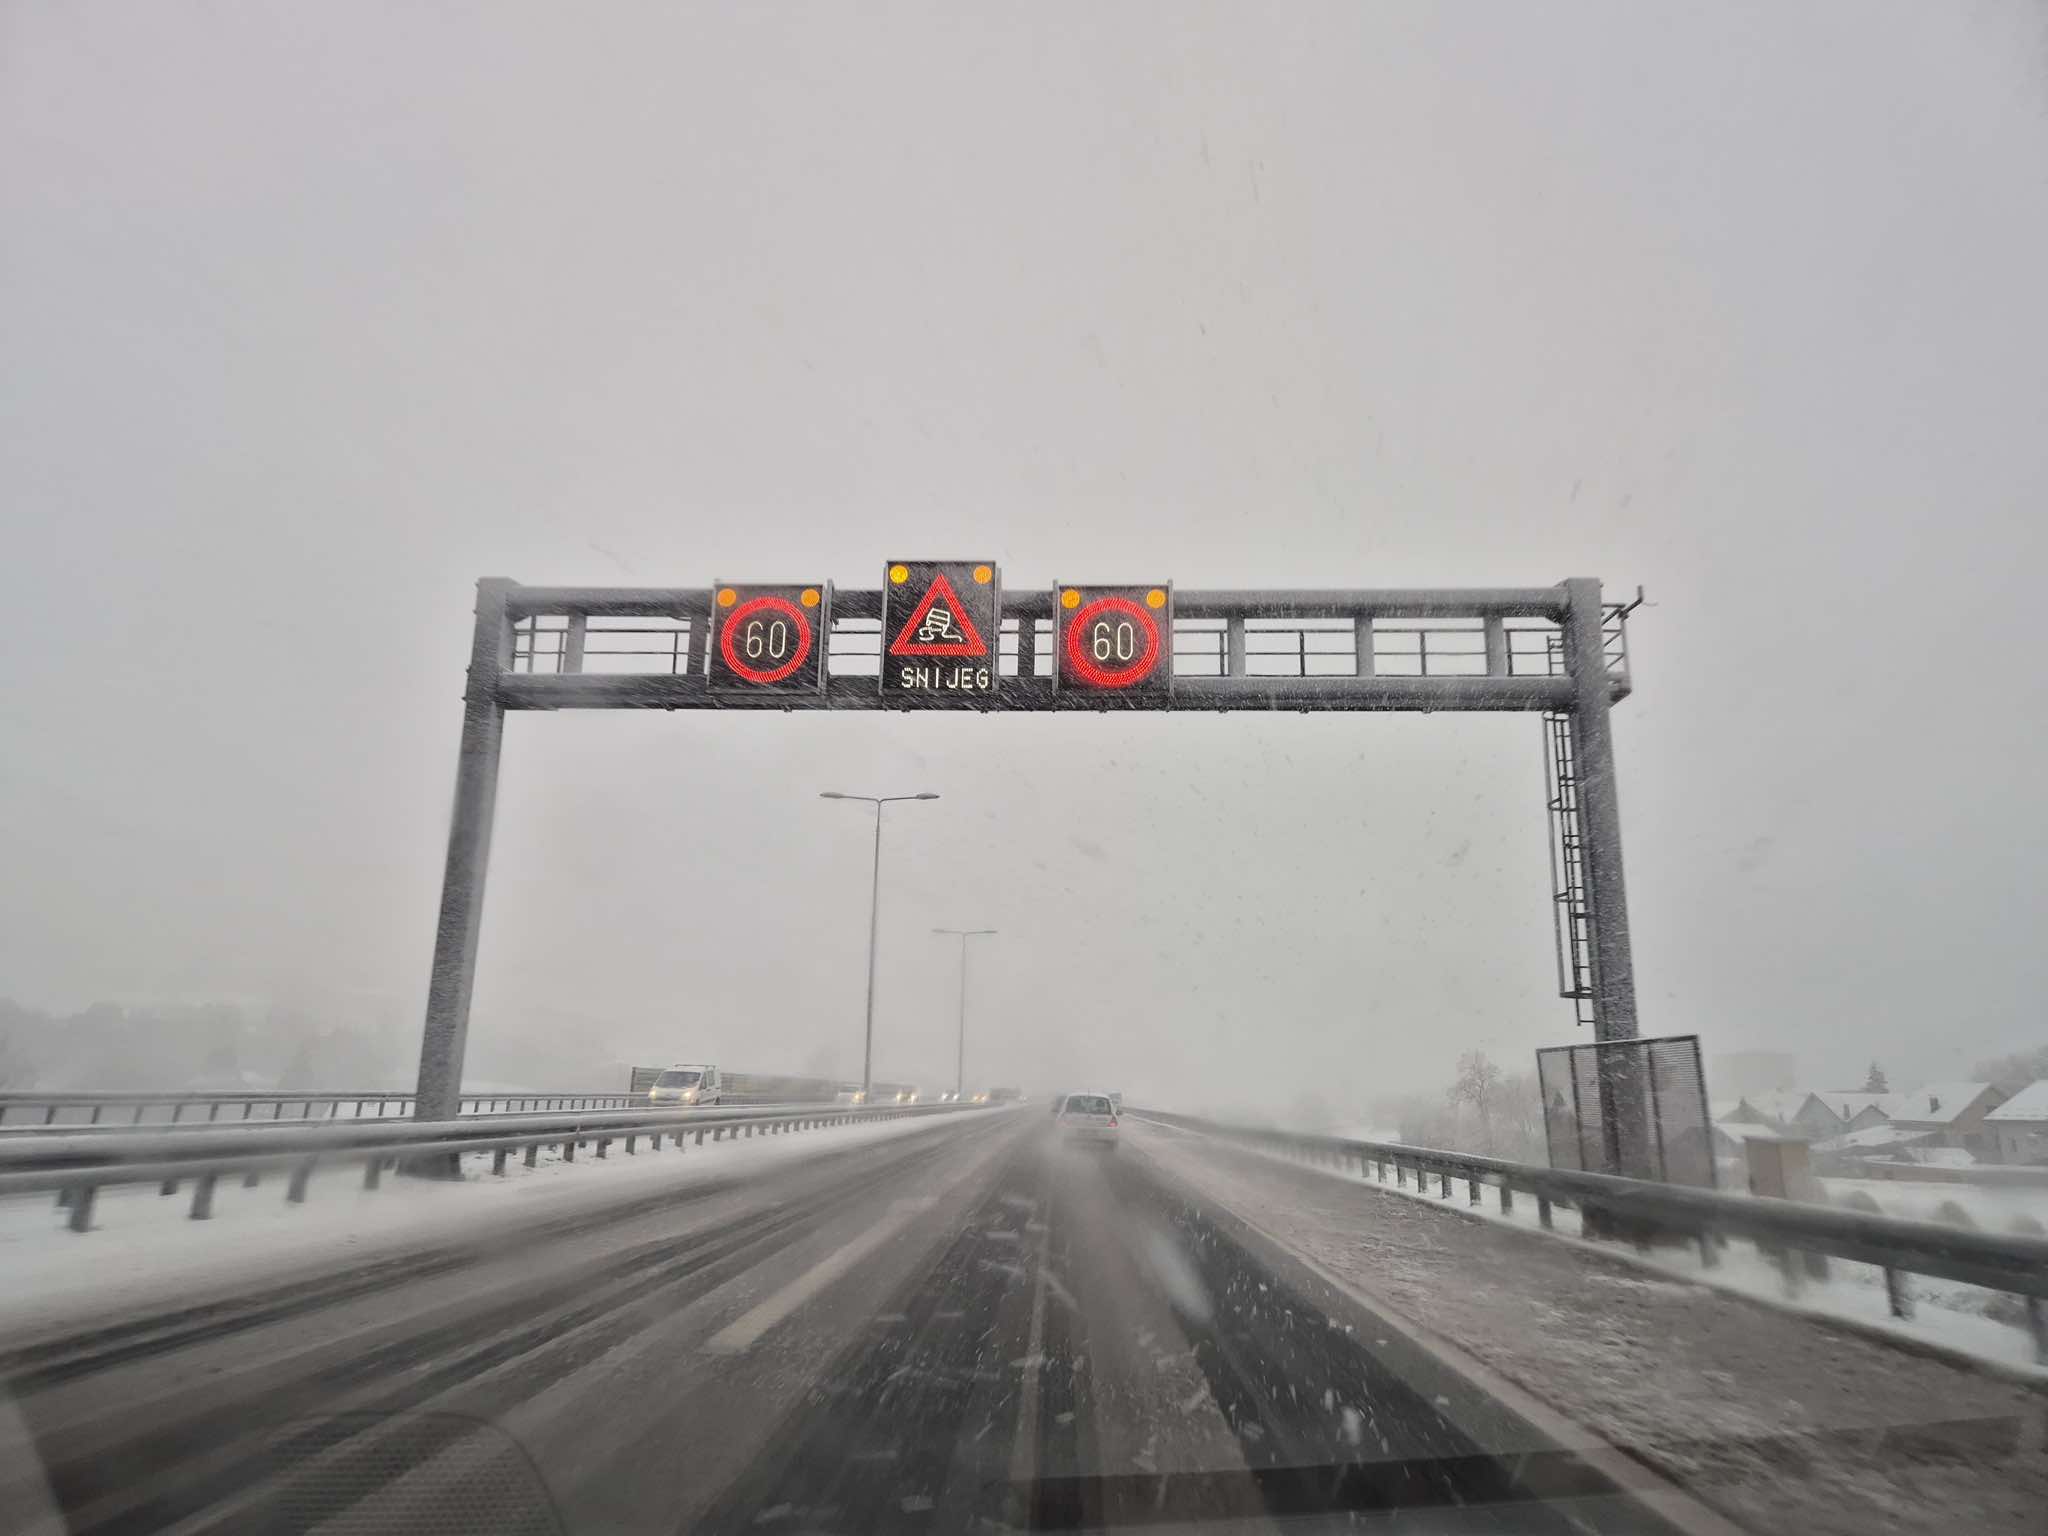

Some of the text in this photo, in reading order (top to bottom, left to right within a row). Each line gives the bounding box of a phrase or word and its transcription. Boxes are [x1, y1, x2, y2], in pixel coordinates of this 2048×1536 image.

[746, 620, 787, 659] 60
[1093, 622, 1134, 661] 60
[901, 667, 989, 689] SNIJEG
